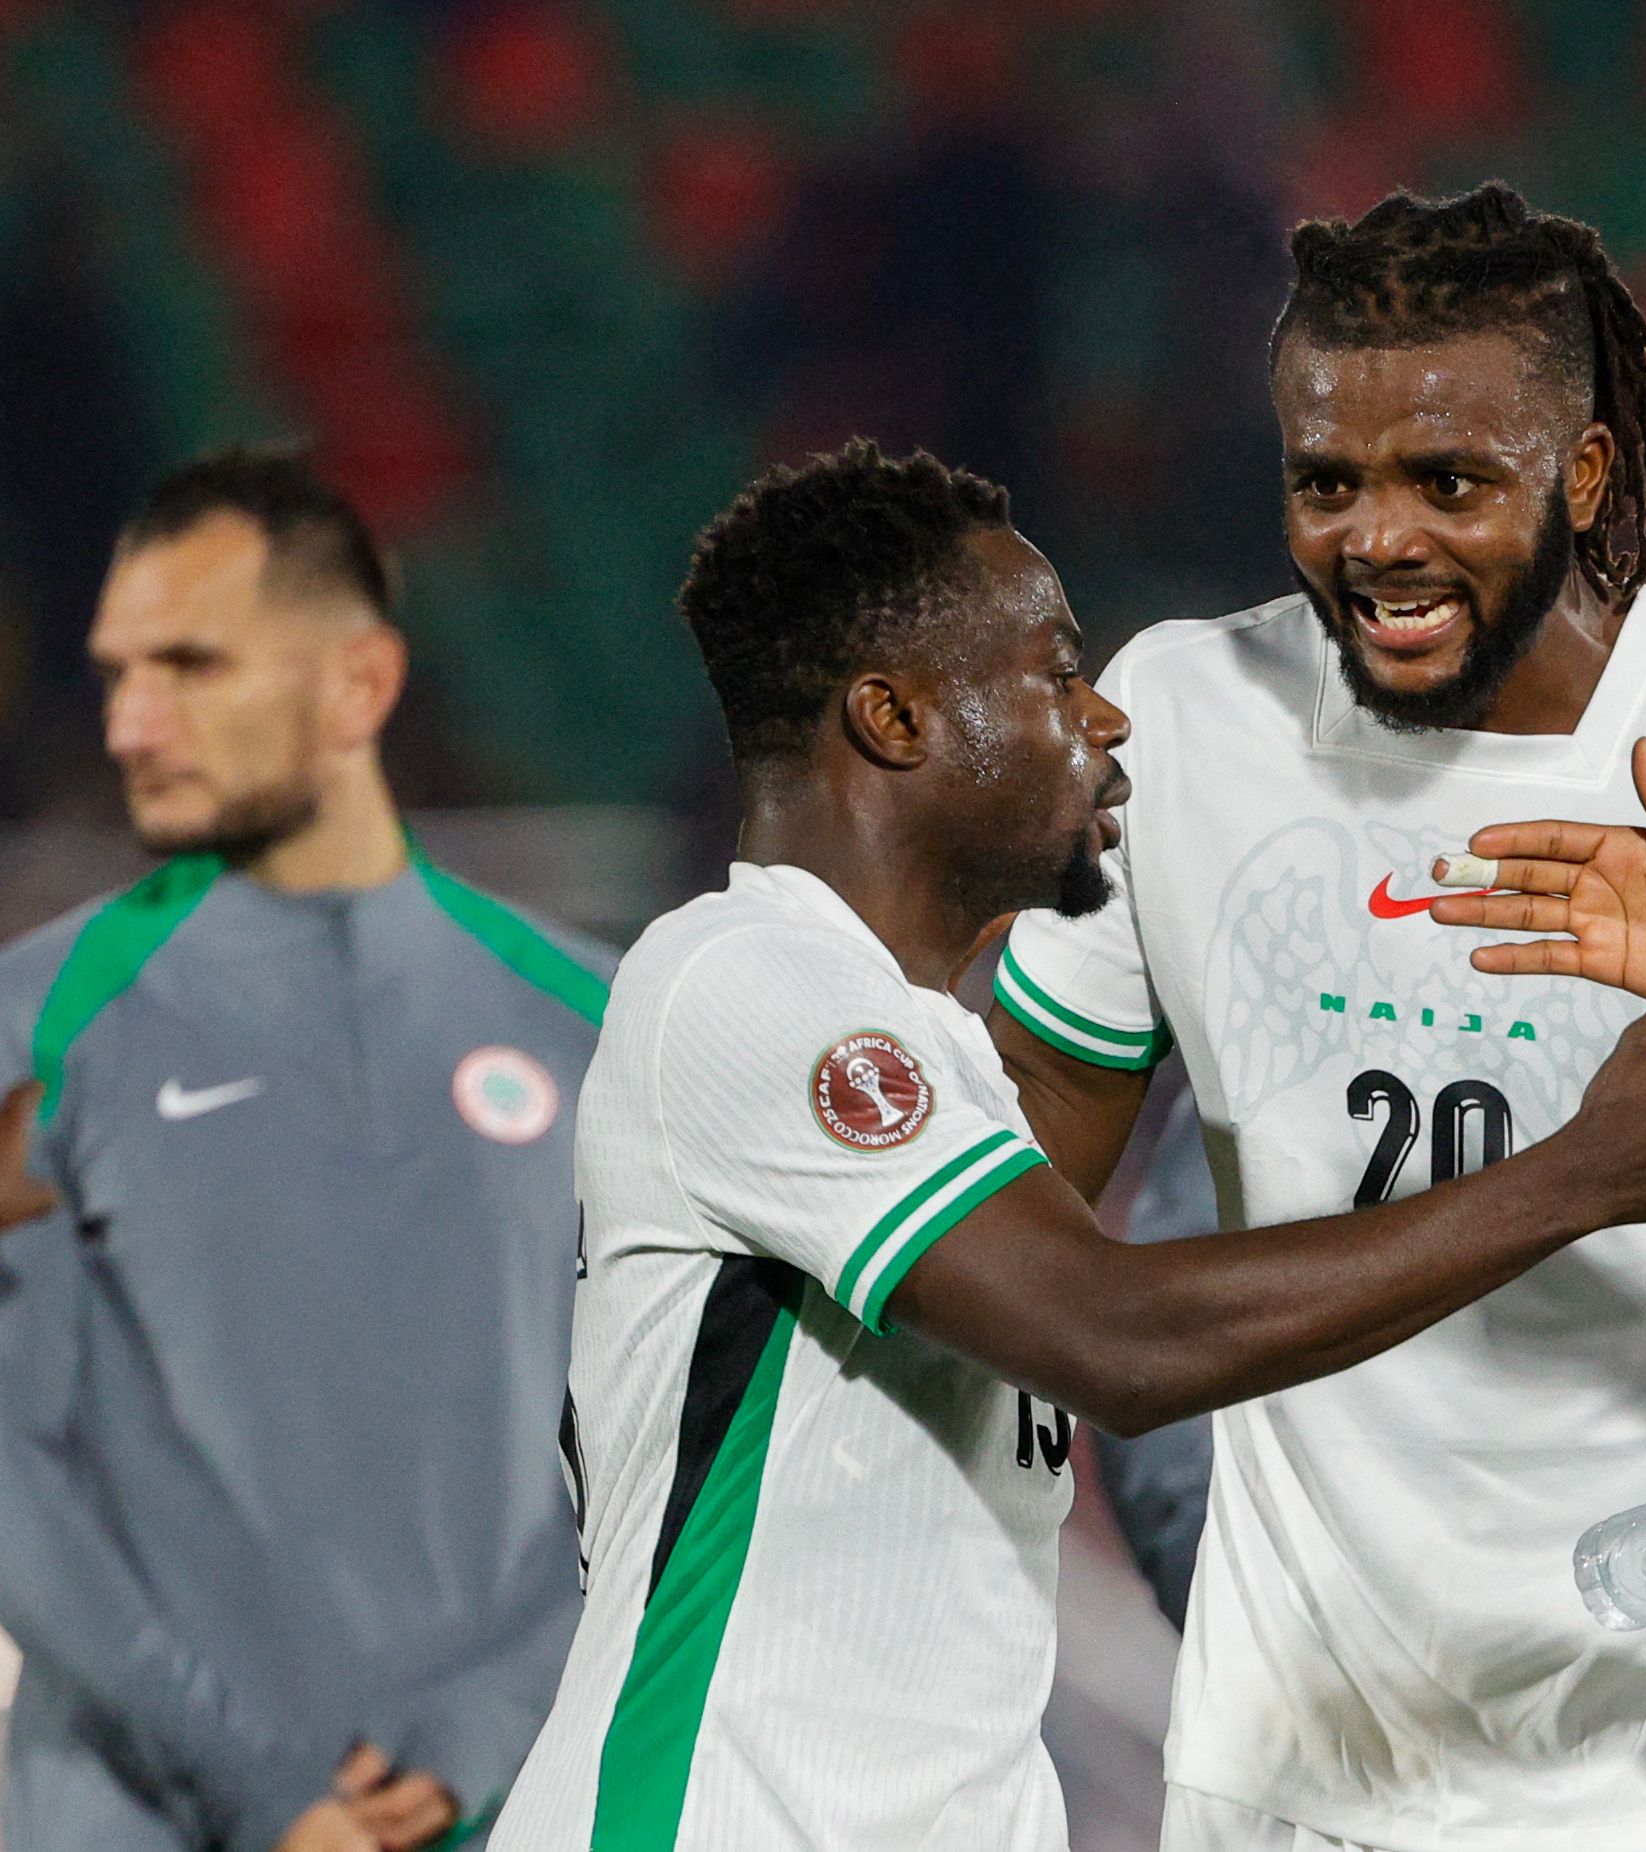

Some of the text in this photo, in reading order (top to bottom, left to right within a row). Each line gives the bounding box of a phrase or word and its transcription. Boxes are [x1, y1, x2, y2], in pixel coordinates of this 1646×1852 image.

[1319, 992, 1537, 1041] NAIJA
[848, 1037, 892, 1053] AFRICA
[893, 1048, 914, 1070] CUP
[901, 1085, 929, 1134] NATIONS
[833, 1122, 902, 1146] MOROCCO
[1346, 1069, 1514, 1211] 20
